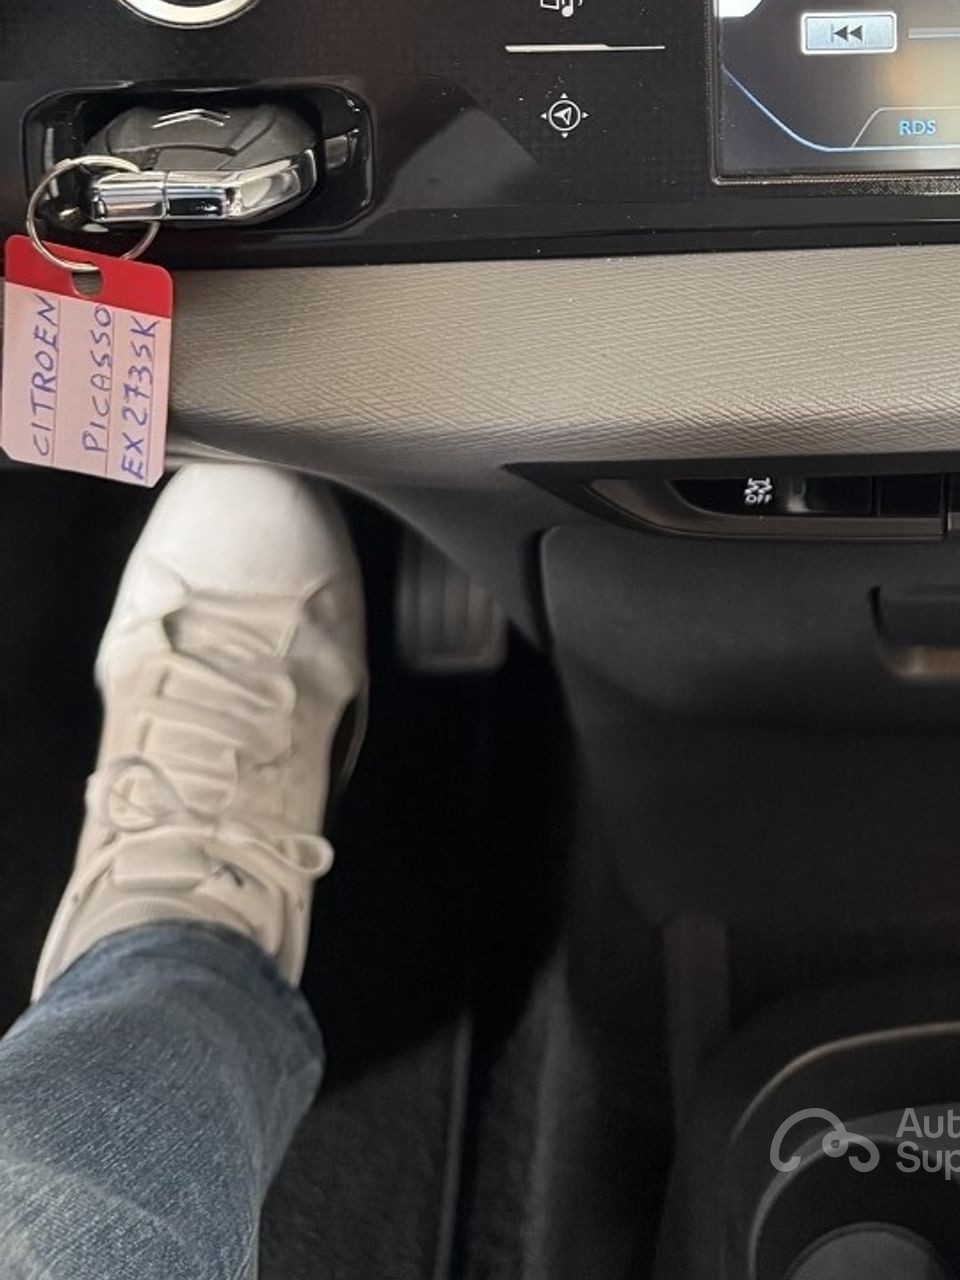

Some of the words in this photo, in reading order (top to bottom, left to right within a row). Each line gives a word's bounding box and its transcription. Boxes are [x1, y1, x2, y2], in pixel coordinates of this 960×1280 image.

[900, 120, 937, 136] RDS
[30, 294, 60, 457] CITROEN
[82, 305, 114, 453] PICASSO
